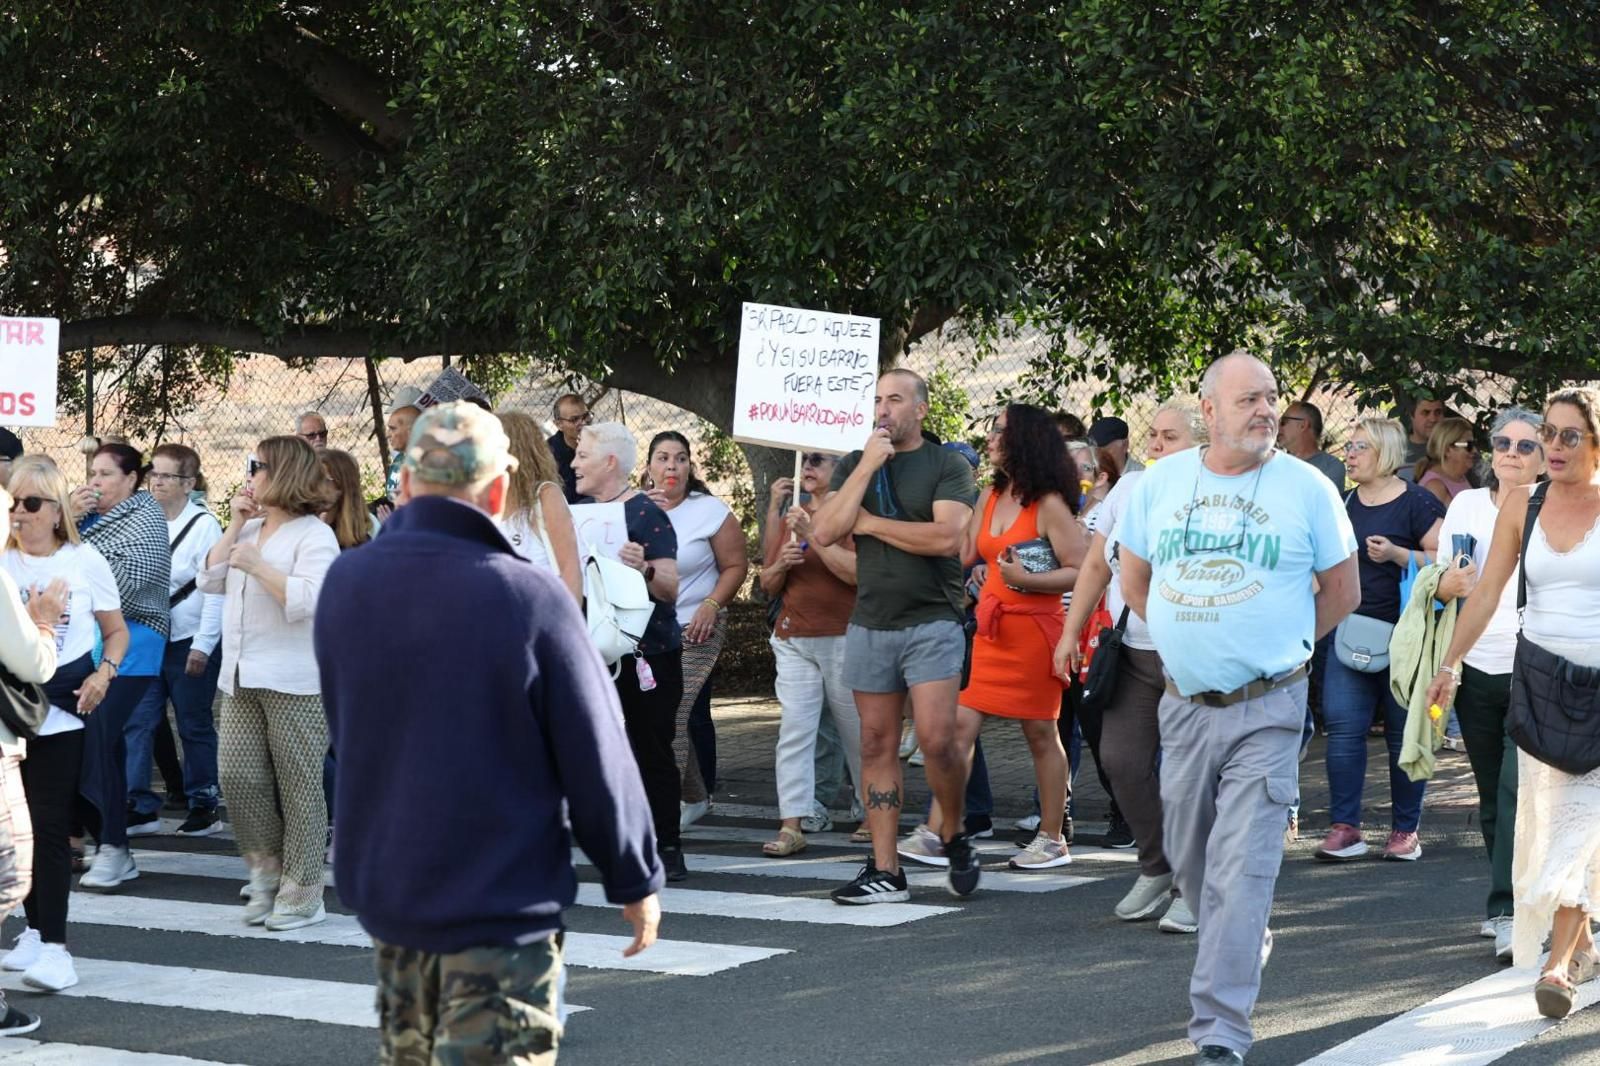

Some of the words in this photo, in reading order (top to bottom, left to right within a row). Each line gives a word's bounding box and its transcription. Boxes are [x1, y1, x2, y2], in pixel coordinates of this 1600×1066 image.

[770, 309, 817, 334] PABLO
[800, 347, 816, 368] SU
[819, 348, 869, 369] BARRIO
[784, 373, 822, 397] FUERA
[828, 372, 874, 400] ESTE?
[1174, 494, 1270, 525] ESTABLISHED
[1156, 528, 1281, 571] BROOKLYN
[1176, 559, 1242, 588] Varsity
[1175, 611, 1220, 623] ESSENZIA
